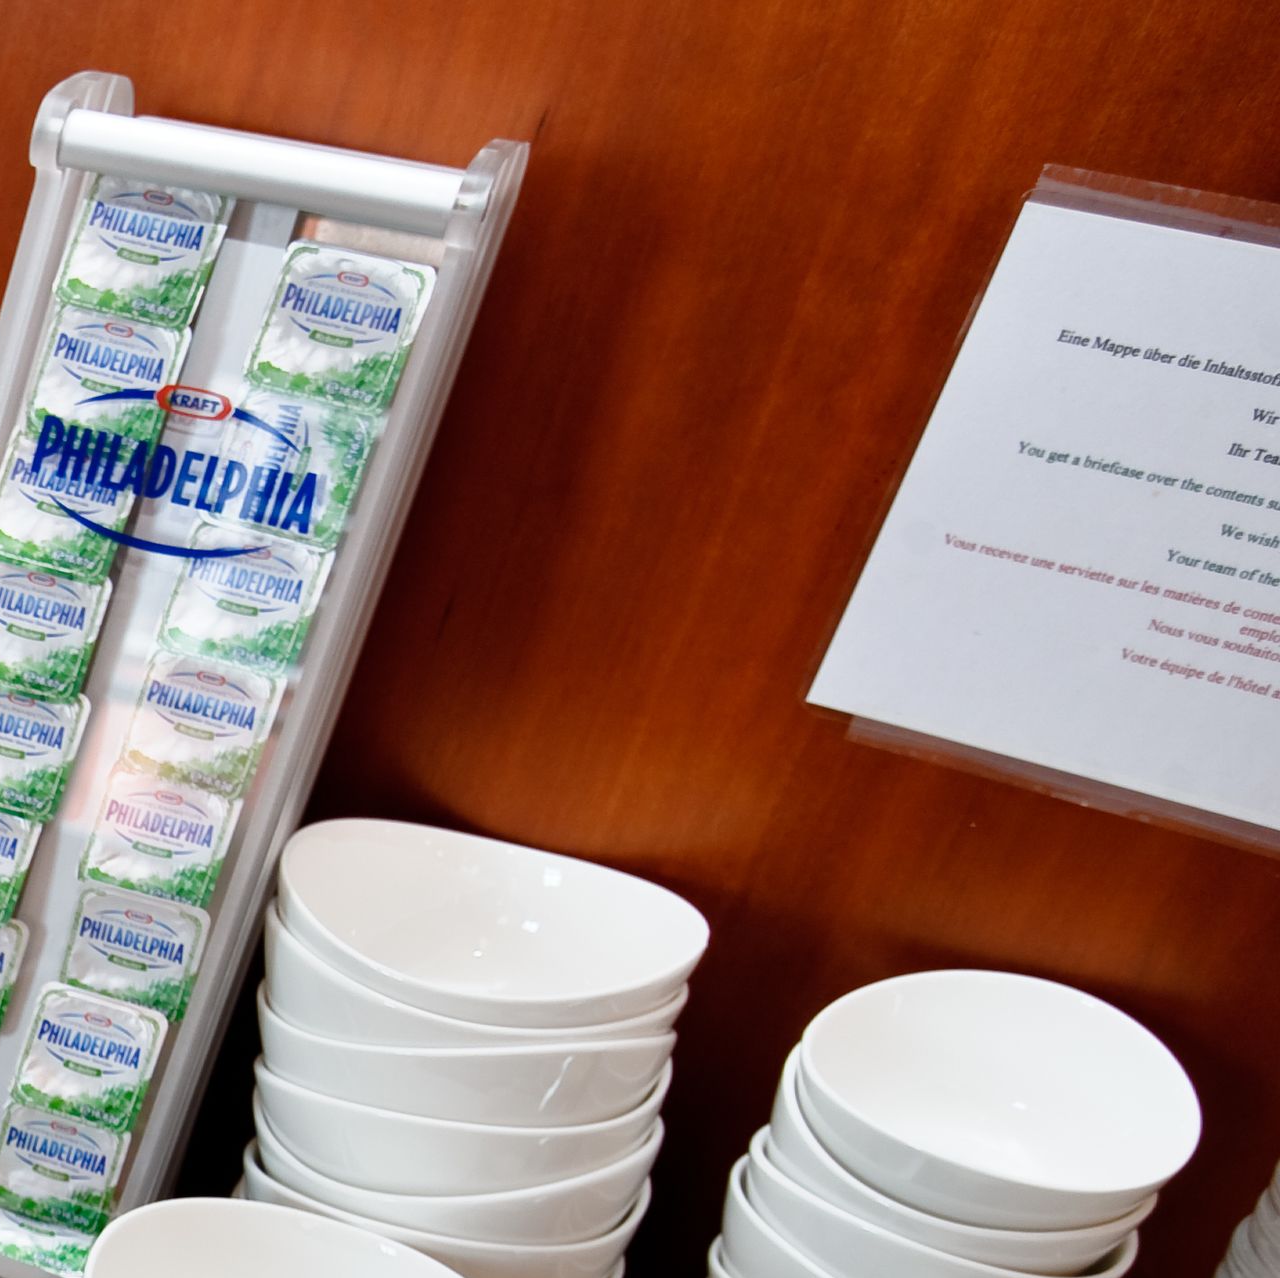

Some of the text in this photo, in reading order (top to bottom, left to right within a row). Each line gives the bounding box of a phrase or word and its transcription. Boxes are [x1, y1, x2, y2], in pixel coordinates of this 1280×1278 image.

[90, 201, 205, 251] PHILADELPHIA
[281, 283, 403, 334] PHILADELPHIA
[54, 332, 165, 384] PHILADELPHIA
[1057, 329, 1090, 347] Eine
[1091, 336, 1140, 359] Mappe
[1143, 347, 1175, 364] über
[1178, 354, 1200, 370] die
[170, 391, 219, 413] KRAFT
[1253, 408, 1280, 425] Wir
[31, 414, 317, 534] PHILADELPHIA
[1018, 441, 1046, 458] You
[1046, 450, 1070, 464] get
[1071, 456, 1081, 466] a
[1083, 455, 1144, 480] briefcase
[1146, 472, 1179, 487] over
[1180, 478, 1203, 493] the
[1205, 485, 1266, 508] contents
[1227, 443, 1280, 466] Ihr Tea
[1220, 523, 1280, 549] We wish
[189, 557, 303, 604] PHILADELPHIA
[945, 533, 977, 551] Vous
[978, 544, 1029, 564] recevez
[1030, 557, 1055, 570] une
[1057, 563, 1114, 585] serviette
[1116, 578, 1139, 589] sur
[1140, 580, 1160, 595] les
[1223, 601, 1241, 615] de
[1167, 549, 1280, 587] Your team of the
[1147, 619, 1184, 638] Nous
[1187, 631, 1219, 647] vous
[1122, 647, 1158, 668] Votre
[1160, 659, 1205, 679] équipe
[1207, 671, 1226, 684] de
[147, 680, 256, 731] PHILADELPHIA
[105, 799, 213, 848] PHILADELPHIA
[79, 916, 183, 965] PHILADELPHIA
[38, 1019, 140, 1069] PHILADELPHIA
[6, 1126, 106, 1175] PHILADELPHIA
